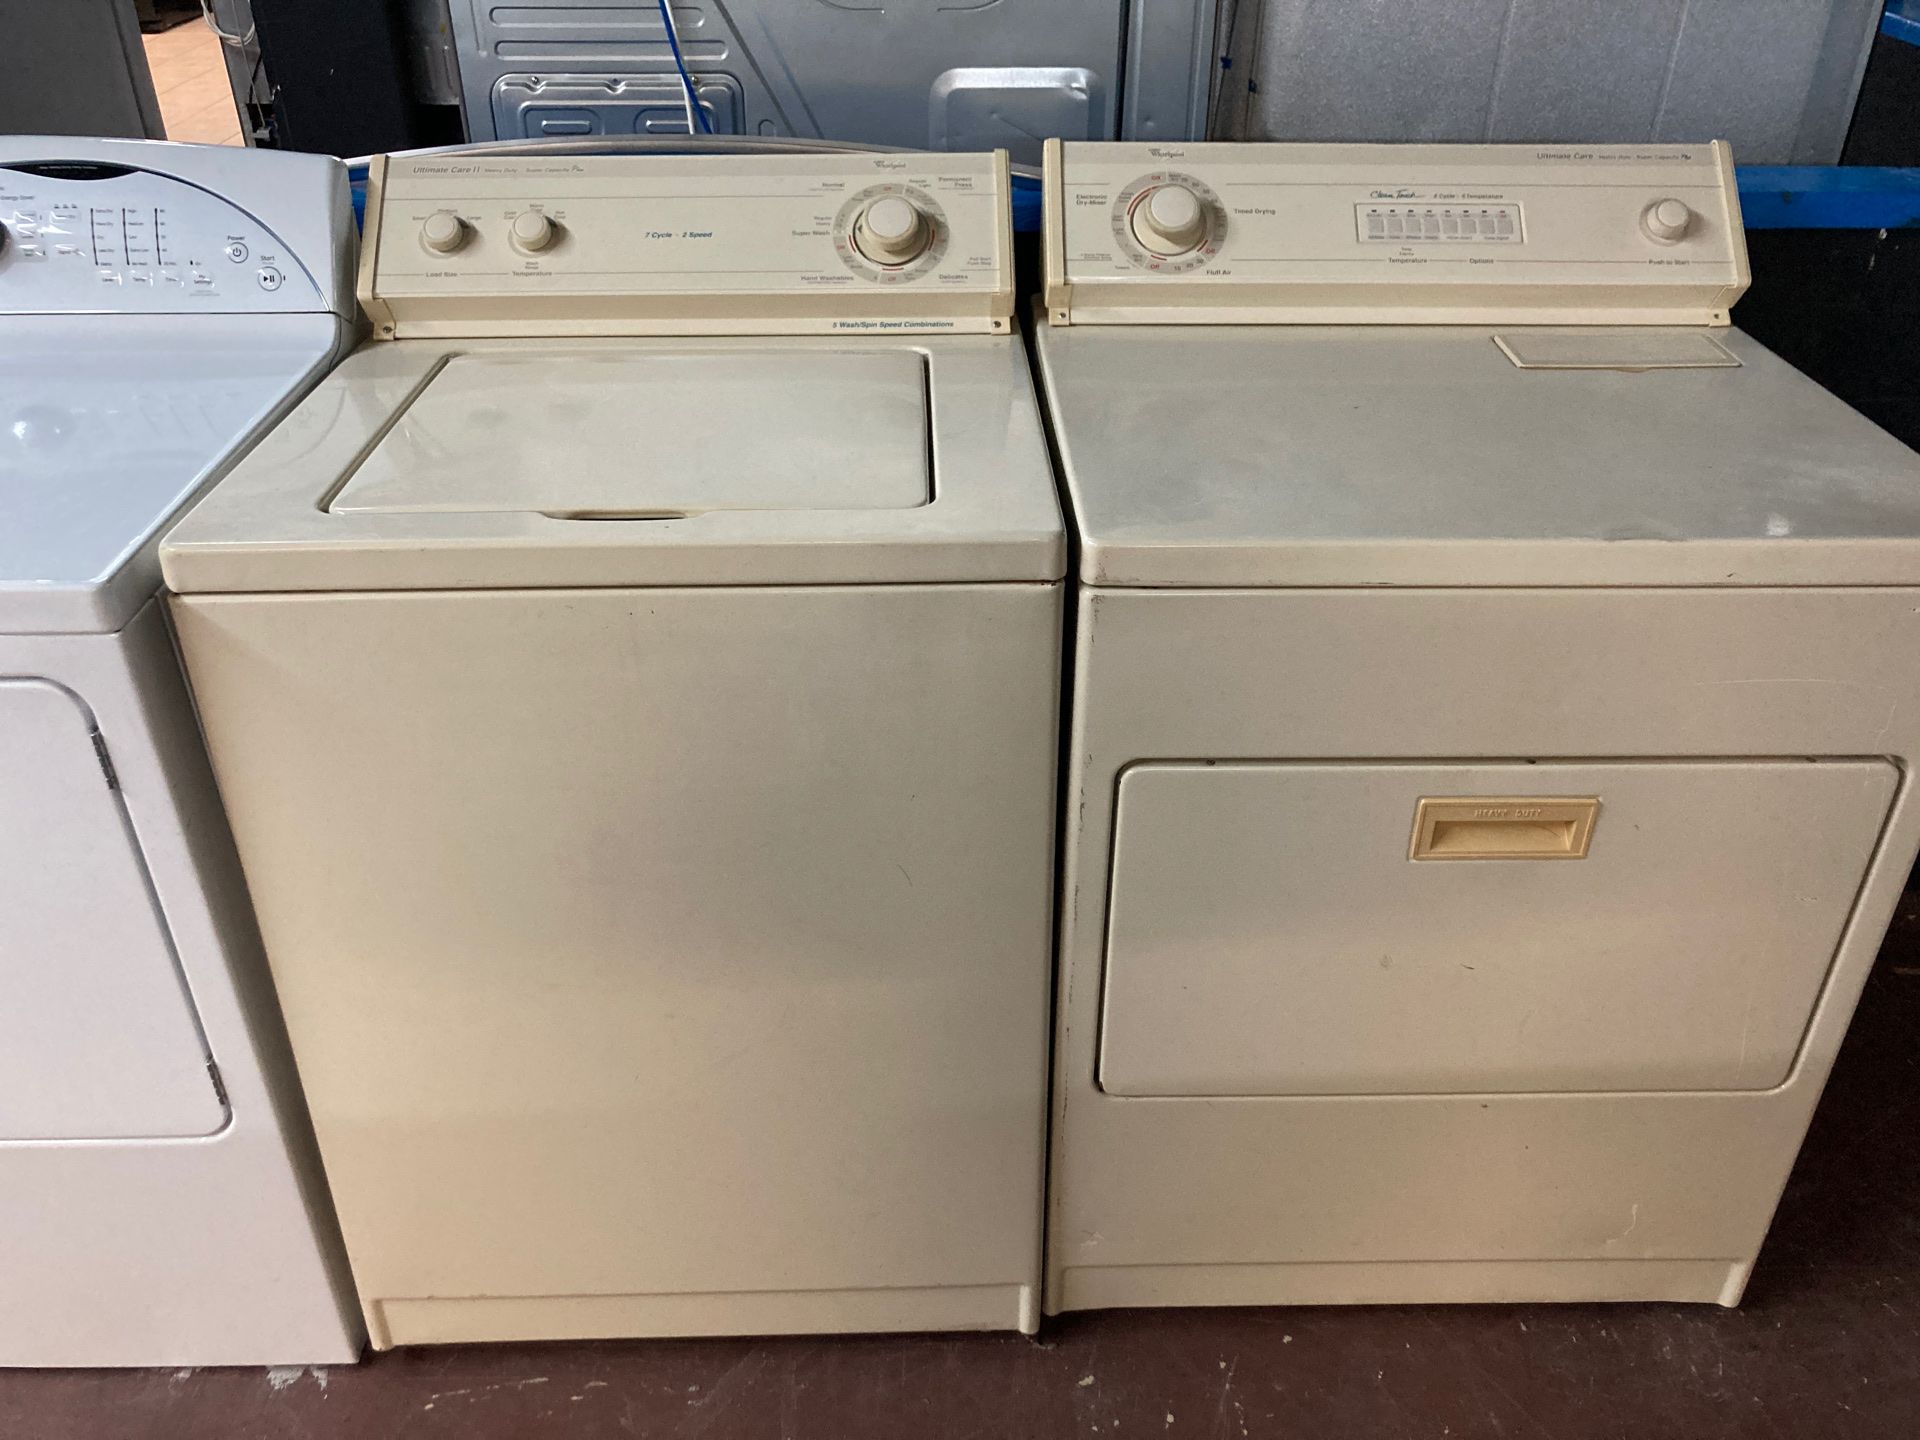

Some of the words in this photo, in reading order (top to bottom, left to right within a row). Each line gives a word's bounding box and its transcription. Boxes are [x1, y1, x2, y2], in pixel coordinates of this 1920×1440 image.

[412, 166, 448, 174] Ultimate
[450, 166, 471, 174] Care
[652, 231, 673, 239] Cycle
[688, 231, 713, 239] Speed
[839, 321, 878, 330] Wash/Spin
[879, 320, 903, 329] Speed
[904, 320, 955, 328] Combinations
